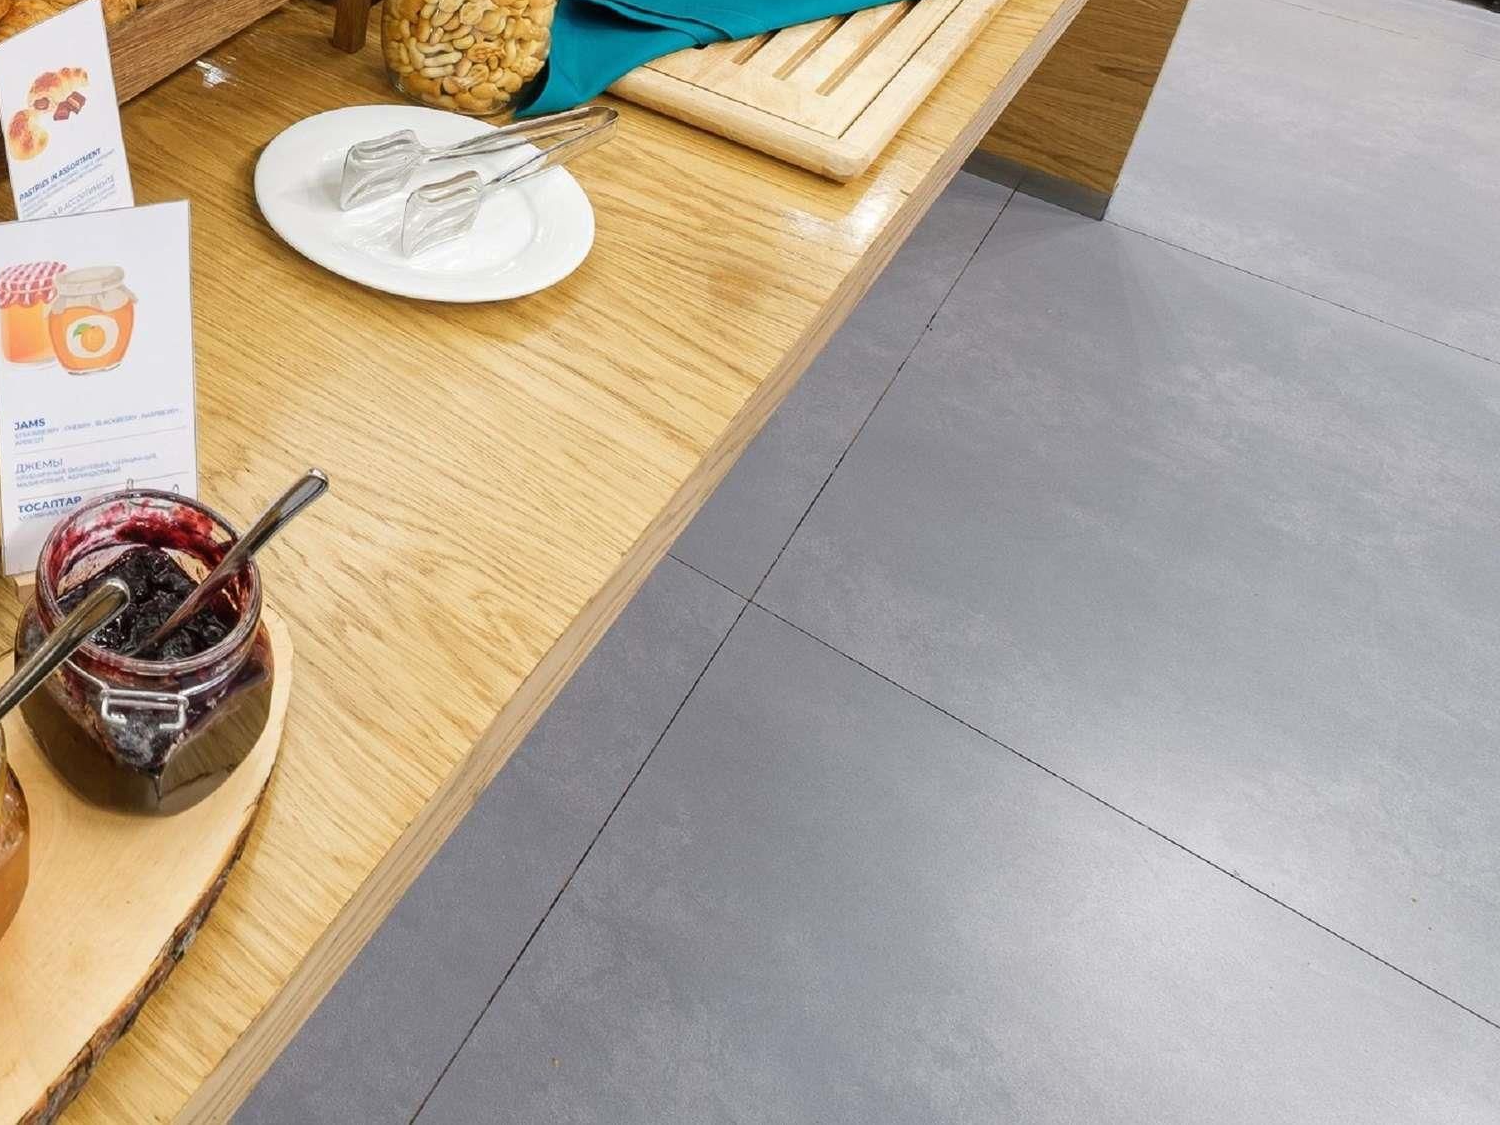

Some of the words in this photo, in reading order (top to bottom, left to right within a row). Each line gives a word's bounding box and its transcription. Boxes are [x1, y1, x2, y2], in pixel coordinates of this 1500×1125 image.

[19, 177, 50, 203] PASTRIES
[50, 171, 58, 184] IN
[58, 147, 102, 178] ASSORTMENT
[14, 417, 46, 431] JAMS
[15, 458, 63, 474] ДЖЕМЫ
[18, 494, 82, 513] ТОСАПТАР
